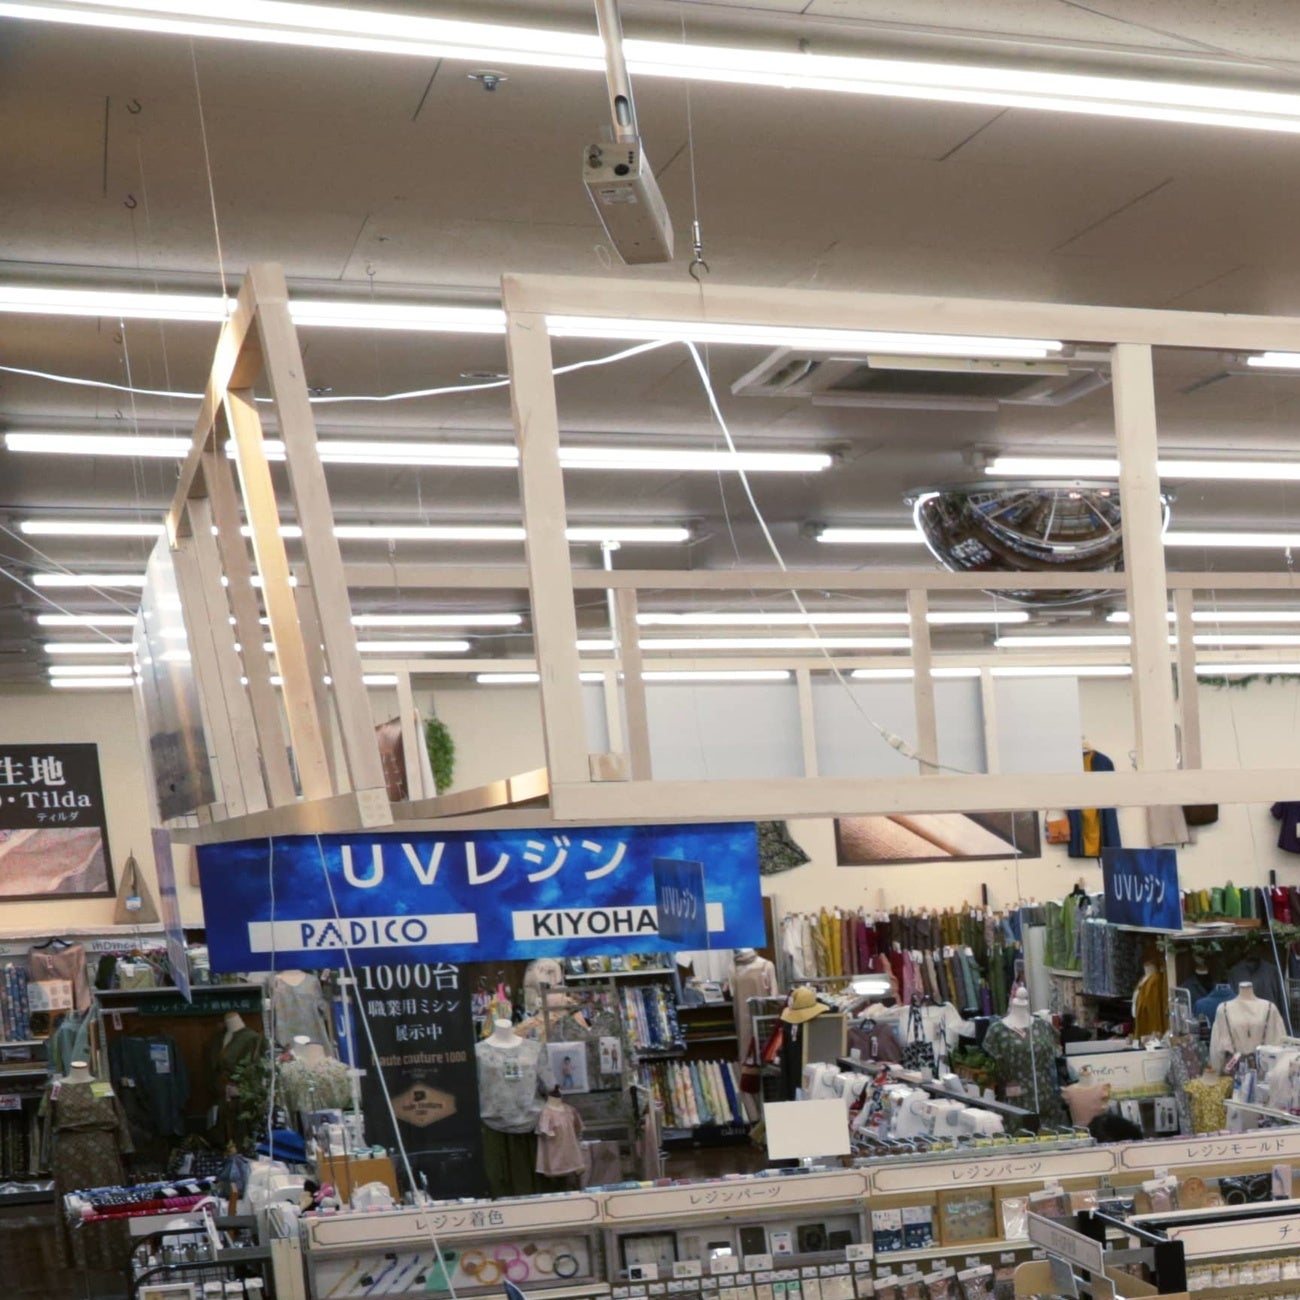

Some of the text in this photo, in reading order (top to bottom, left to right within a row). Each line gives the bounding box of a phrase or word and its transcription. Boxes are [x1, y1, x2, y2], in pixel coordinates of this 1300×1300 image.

[36, 811, 79, 823] ティルダ
[340, 835, 628, 889] UVレジン
[1113, 872, 1165, 904] UVレジン
[660, 885, 698, 921] UVレジン
[300, 918, 428, 948] PADICO
[533, 908, 658, 937] KIYOHA
[361, 962, 460, 991] 1000台
[367, 998, 461, 1018] 職業用ミシン
[395, 1023, 444, 1042] 展示中
[403, 1052, 443, 1066] couture
[445, 1050, 467, 1063] 1000
[1186, 1138, 1286, 1160] レジンモールド
[951, 1160, 1043, 1181] レジンパーツ
[690, 1184, 783, 1206] レジンパーツ
[415, 1209, 506, 1231] レジン着色
